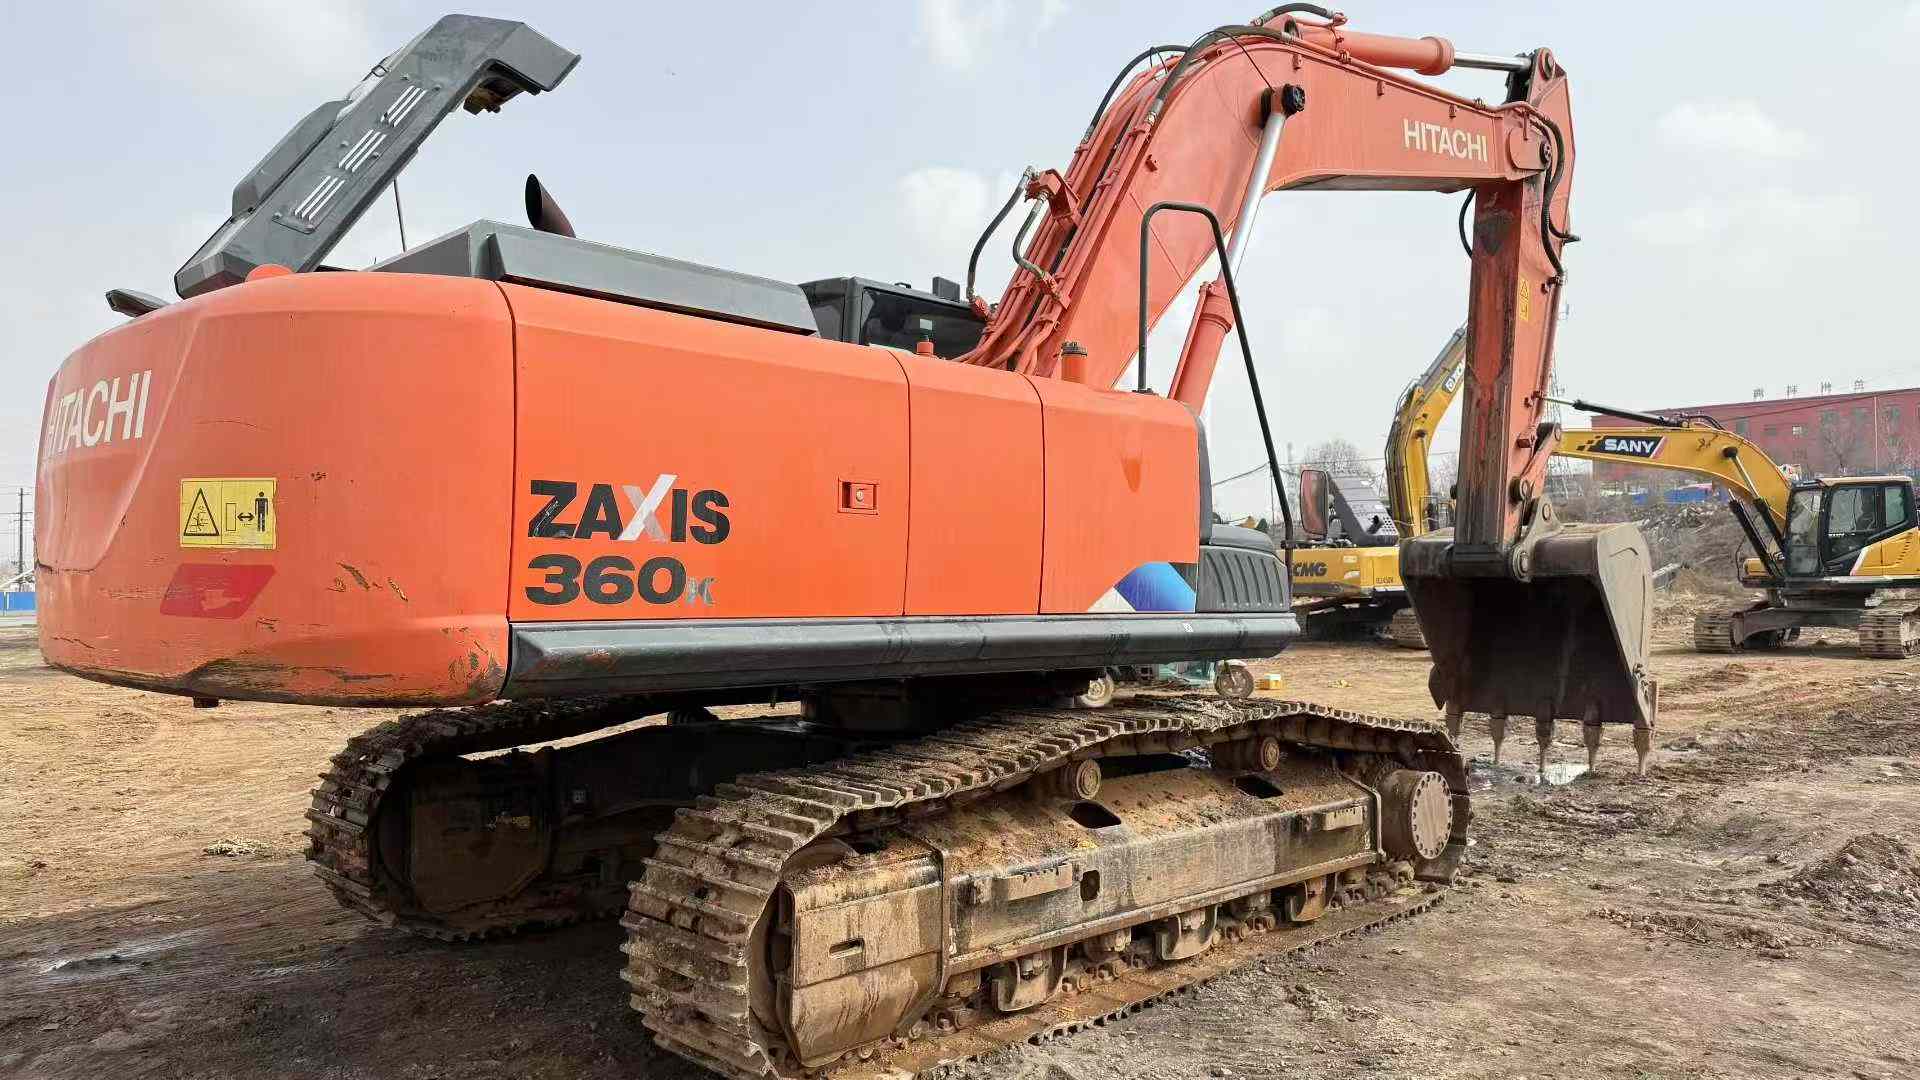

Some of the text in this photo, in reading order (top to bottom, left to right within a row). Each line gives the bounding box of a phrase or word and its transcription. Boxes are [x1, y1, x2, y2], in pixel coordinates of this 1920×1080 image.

[1403, 118, 1488, 162] HITACHI
[44, 369, 152, 455] HITACHI
[1604, 438, 1655, 454] SANY
[528, 474, 731, 545] ZAXIS
[1291, 561, 1329, 577] CMG
